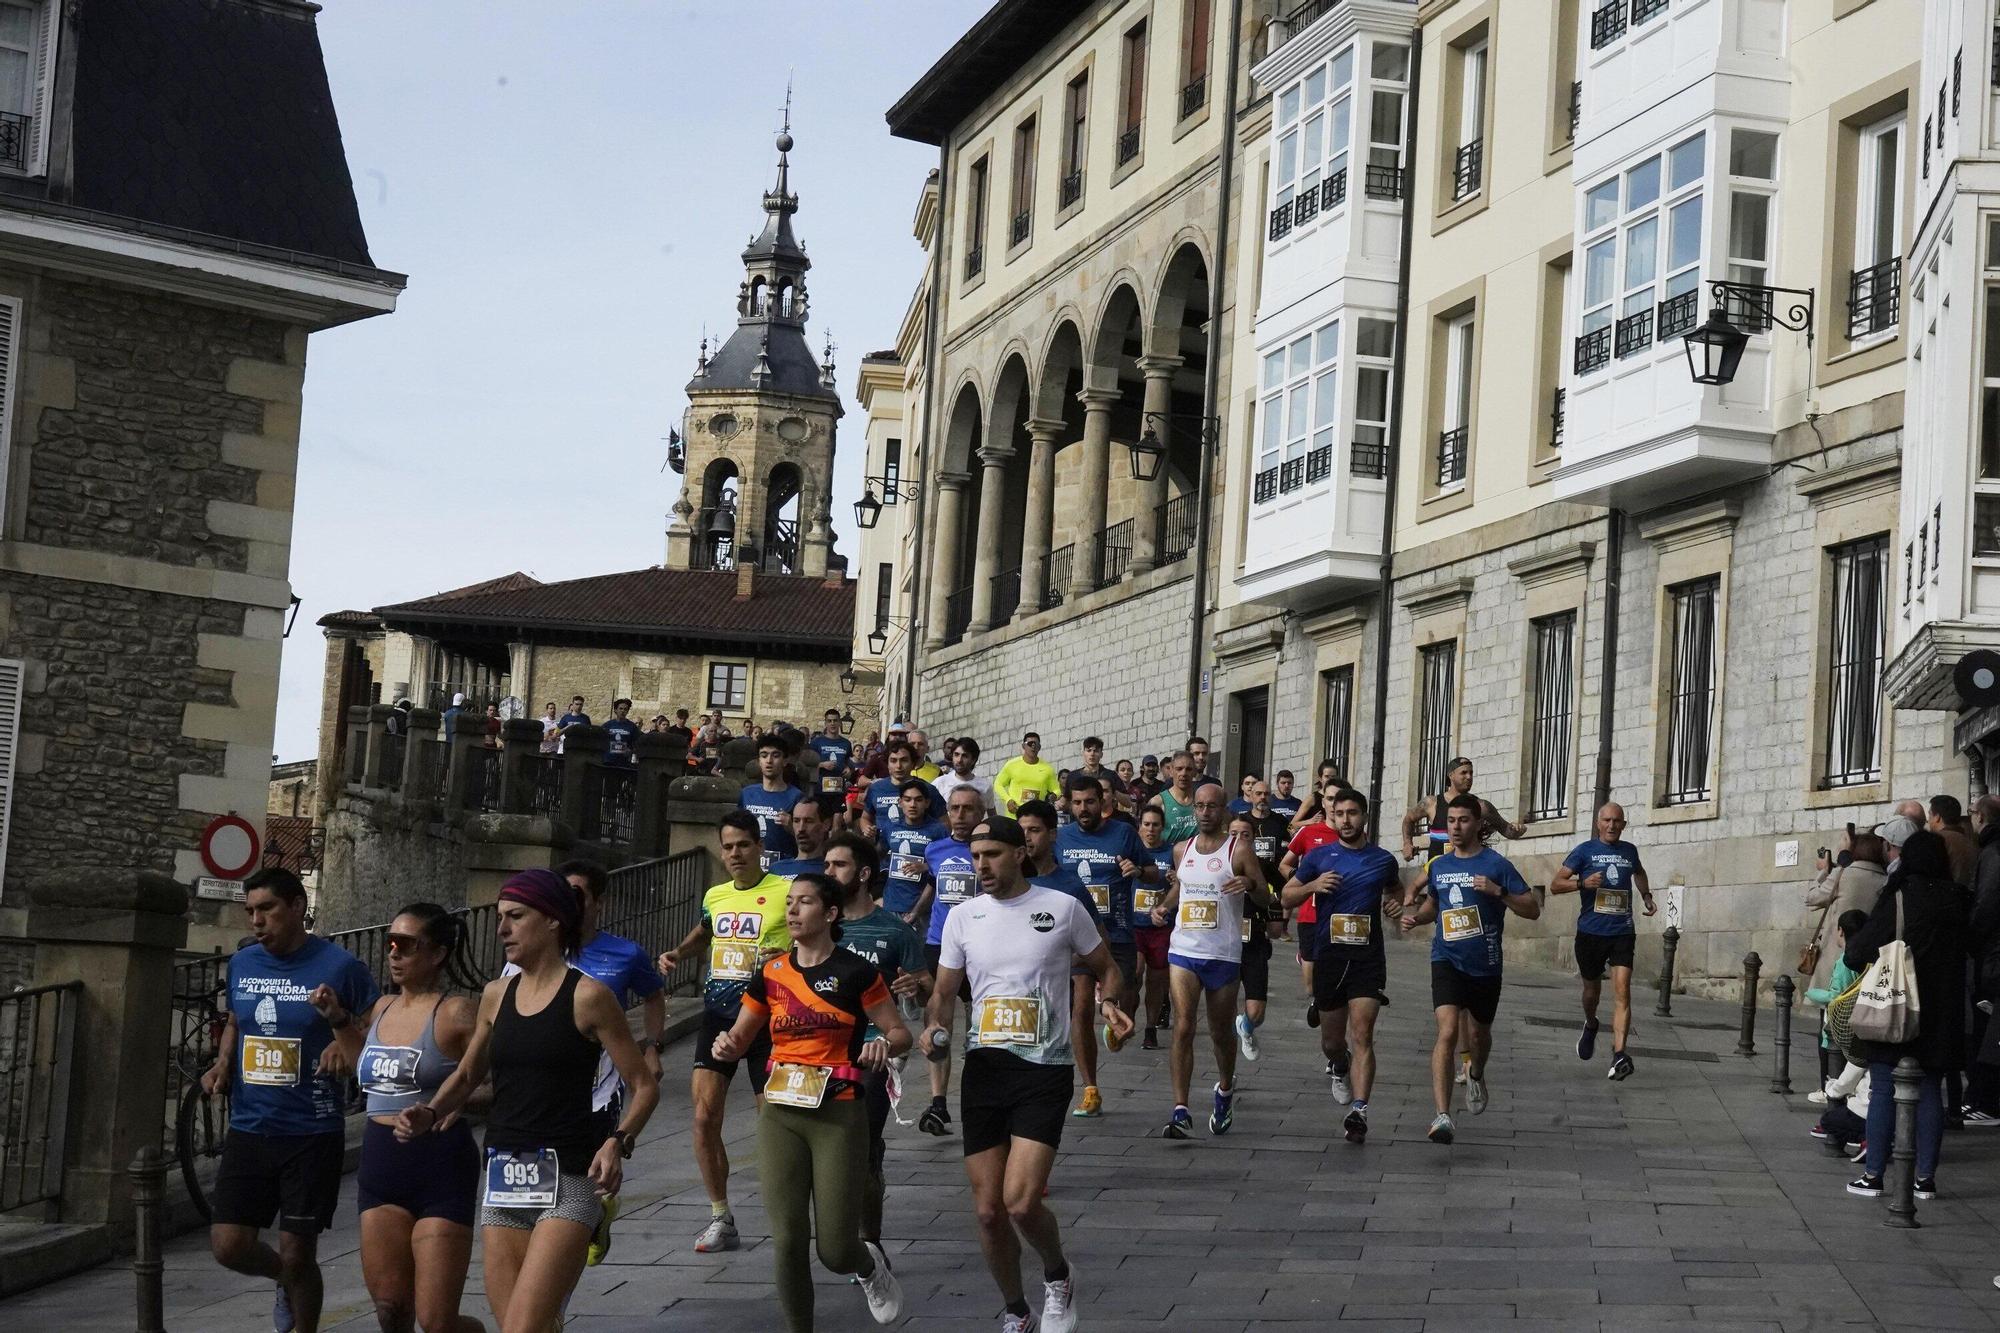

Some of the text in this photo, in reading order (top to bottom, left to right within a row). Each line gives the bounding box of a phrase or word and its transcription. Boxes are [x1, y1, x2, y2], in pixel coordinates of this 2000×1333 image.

[945, 879, 965, 892] 804
[1189, 906, 1207, 919] 527
[1343, 921, 1357, 933] 86
[1449, 915, 1470, 929] 358
[723, 952, 744, 966] 679
[246, 977, 292, 986] CONQUISTA
[246, 984, 307, 995] ALMENDRA
[774, 1012, 839, 1028] FORONDA
[993, 1008, 1022, 1027] 331
[256, 1048, 282, 1068] 519
[371, 1058, 400, 1079] 946
[503, 1163, 540, 1186] 993
